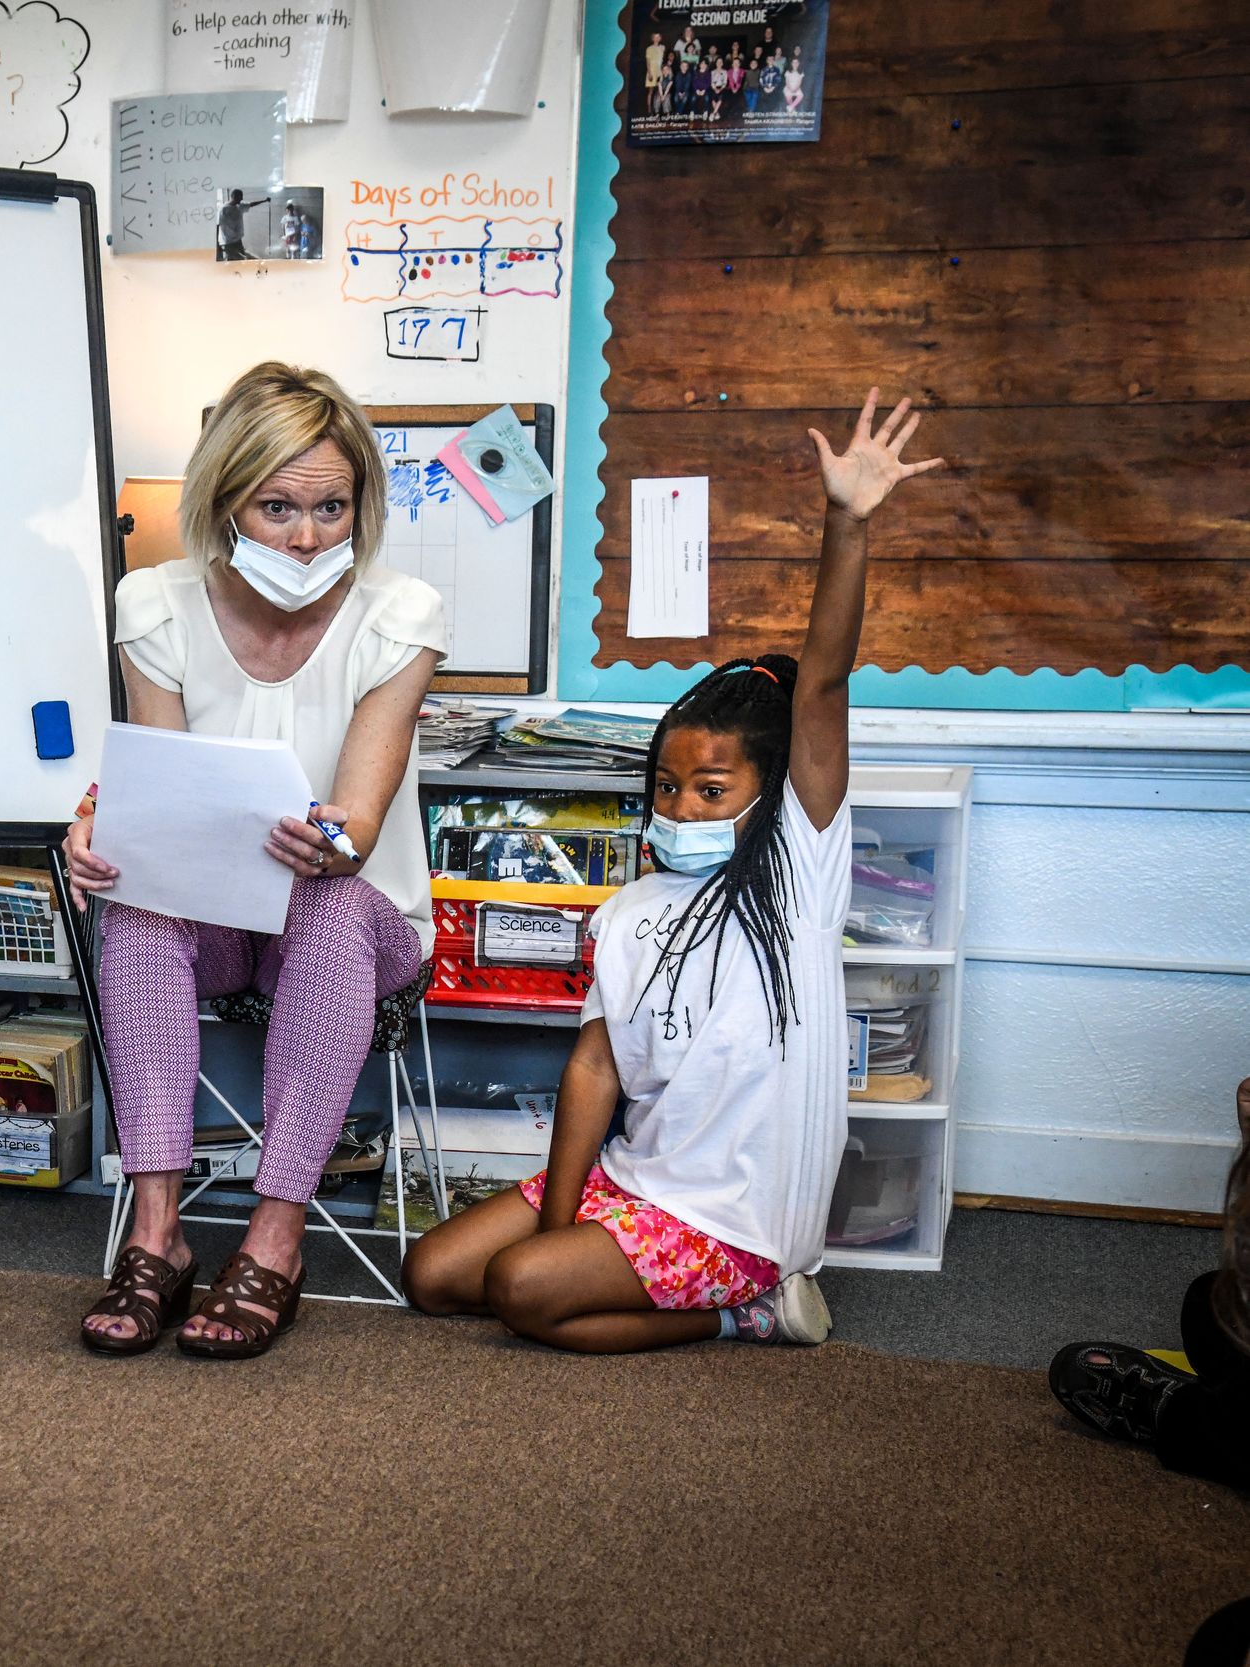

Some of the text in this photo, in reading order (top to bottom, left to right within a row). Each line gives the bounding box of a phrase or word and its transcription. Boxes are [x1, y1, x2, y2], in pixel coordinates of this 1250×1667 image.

[172, 20, 188, 37] 6.
[195, 12, 227, 35] Help
[231, 11, 268, 27] each
[272, 8, 311, 27] other
[689, 9, 768, 27] SECOND GRADE
[160, 102, 228, 129] elbow
[160, 139, 225, 164] elbow
[163, 170, 215, 196] knee
[350, 172, 554, 219] Days of School
[167, 200, 216, 227] knee
[356, 232, 372, 249] H
[428, 230, 446, 247] T
[499, 915, 562, 935] Science
[928, 968, 941, 993] 2
